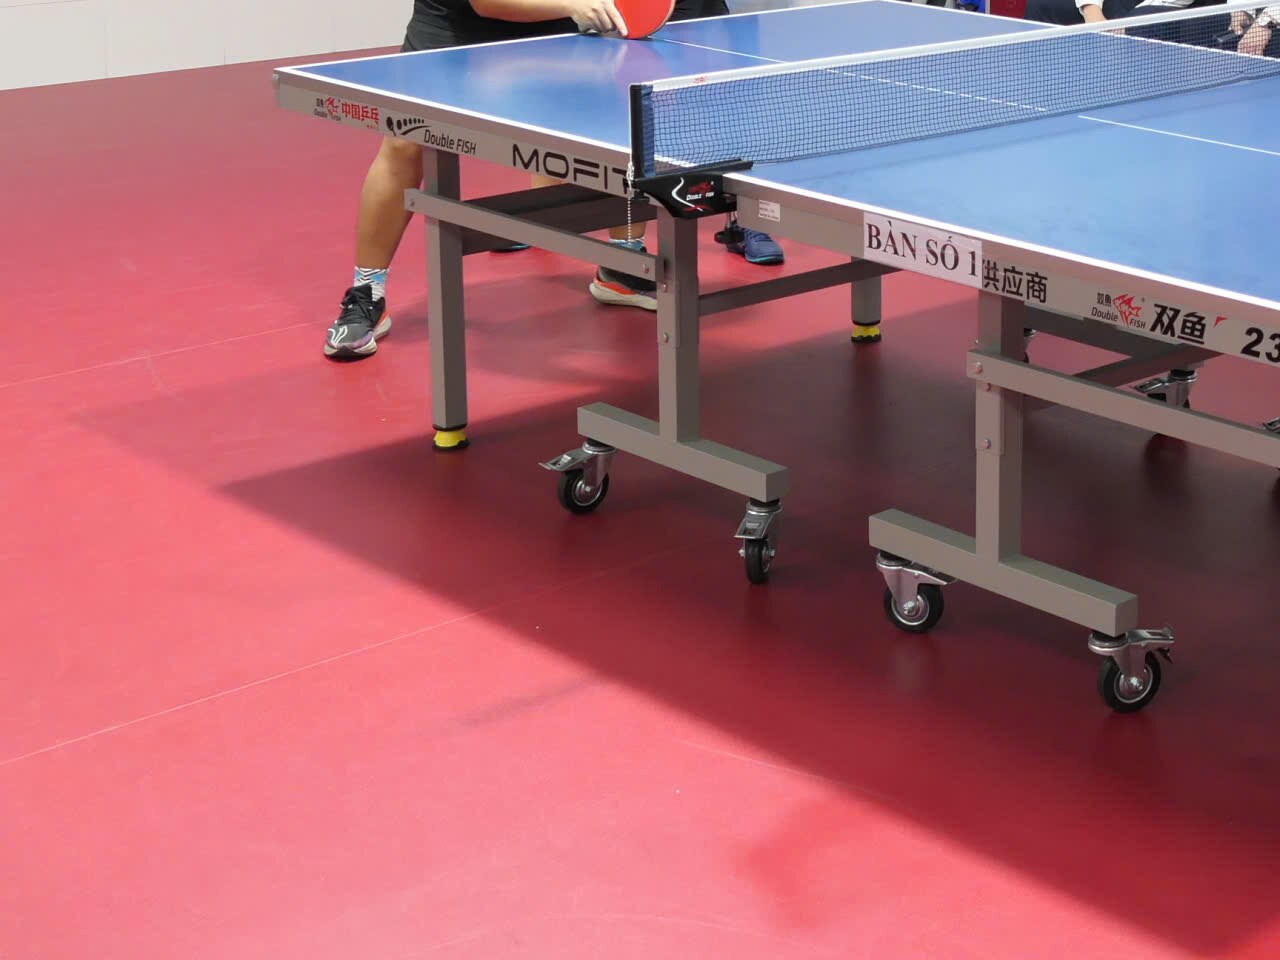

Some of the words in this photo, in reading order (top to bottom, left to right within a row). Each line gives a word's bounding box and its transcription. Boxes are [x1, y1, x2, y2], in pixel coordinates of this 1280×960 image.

[341, 101, 379, 126] 中国乒乓
[424, 128, 455, 150] Double
[456, 138, 477, 155] FISH
[867, 220, 917, 262] BÀN
[925, 236, 960, 271] SỐ
[968, 250, 979, 277] 1
[981, 256, 1049, 305] 供应商
[1091, 306, 1119, 322] Double
[1130, 318, 1147, 330] FISH
[1149, 302, 1209, 346] 双鱼
